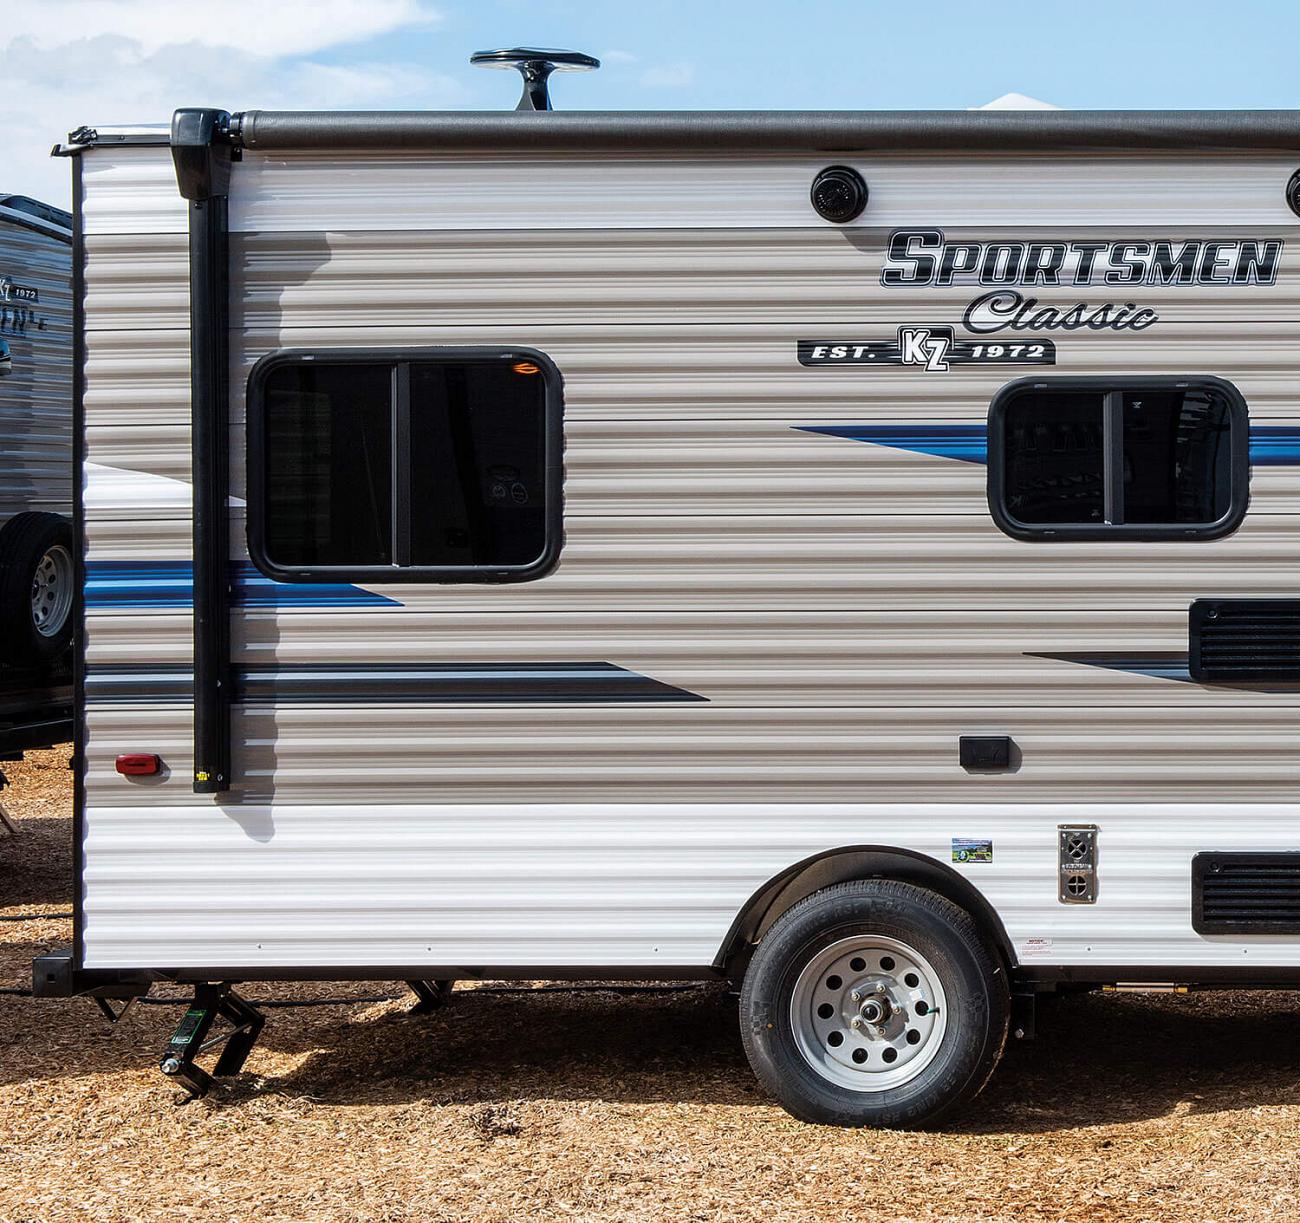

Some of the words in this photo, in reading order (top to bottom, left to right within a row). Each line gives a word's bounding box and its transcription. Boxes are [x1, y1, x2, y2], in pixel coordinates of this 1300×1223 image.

[880, 228, 1285, 288] SPORTSMEN
[16, 289, 36, 299] 1972
[962, 290, 1160, 333] Classic
[811, 345, 876, 359] EST.
[901, 329, 950, 371] KZ
[970, 345, 1046, 359] 1972
